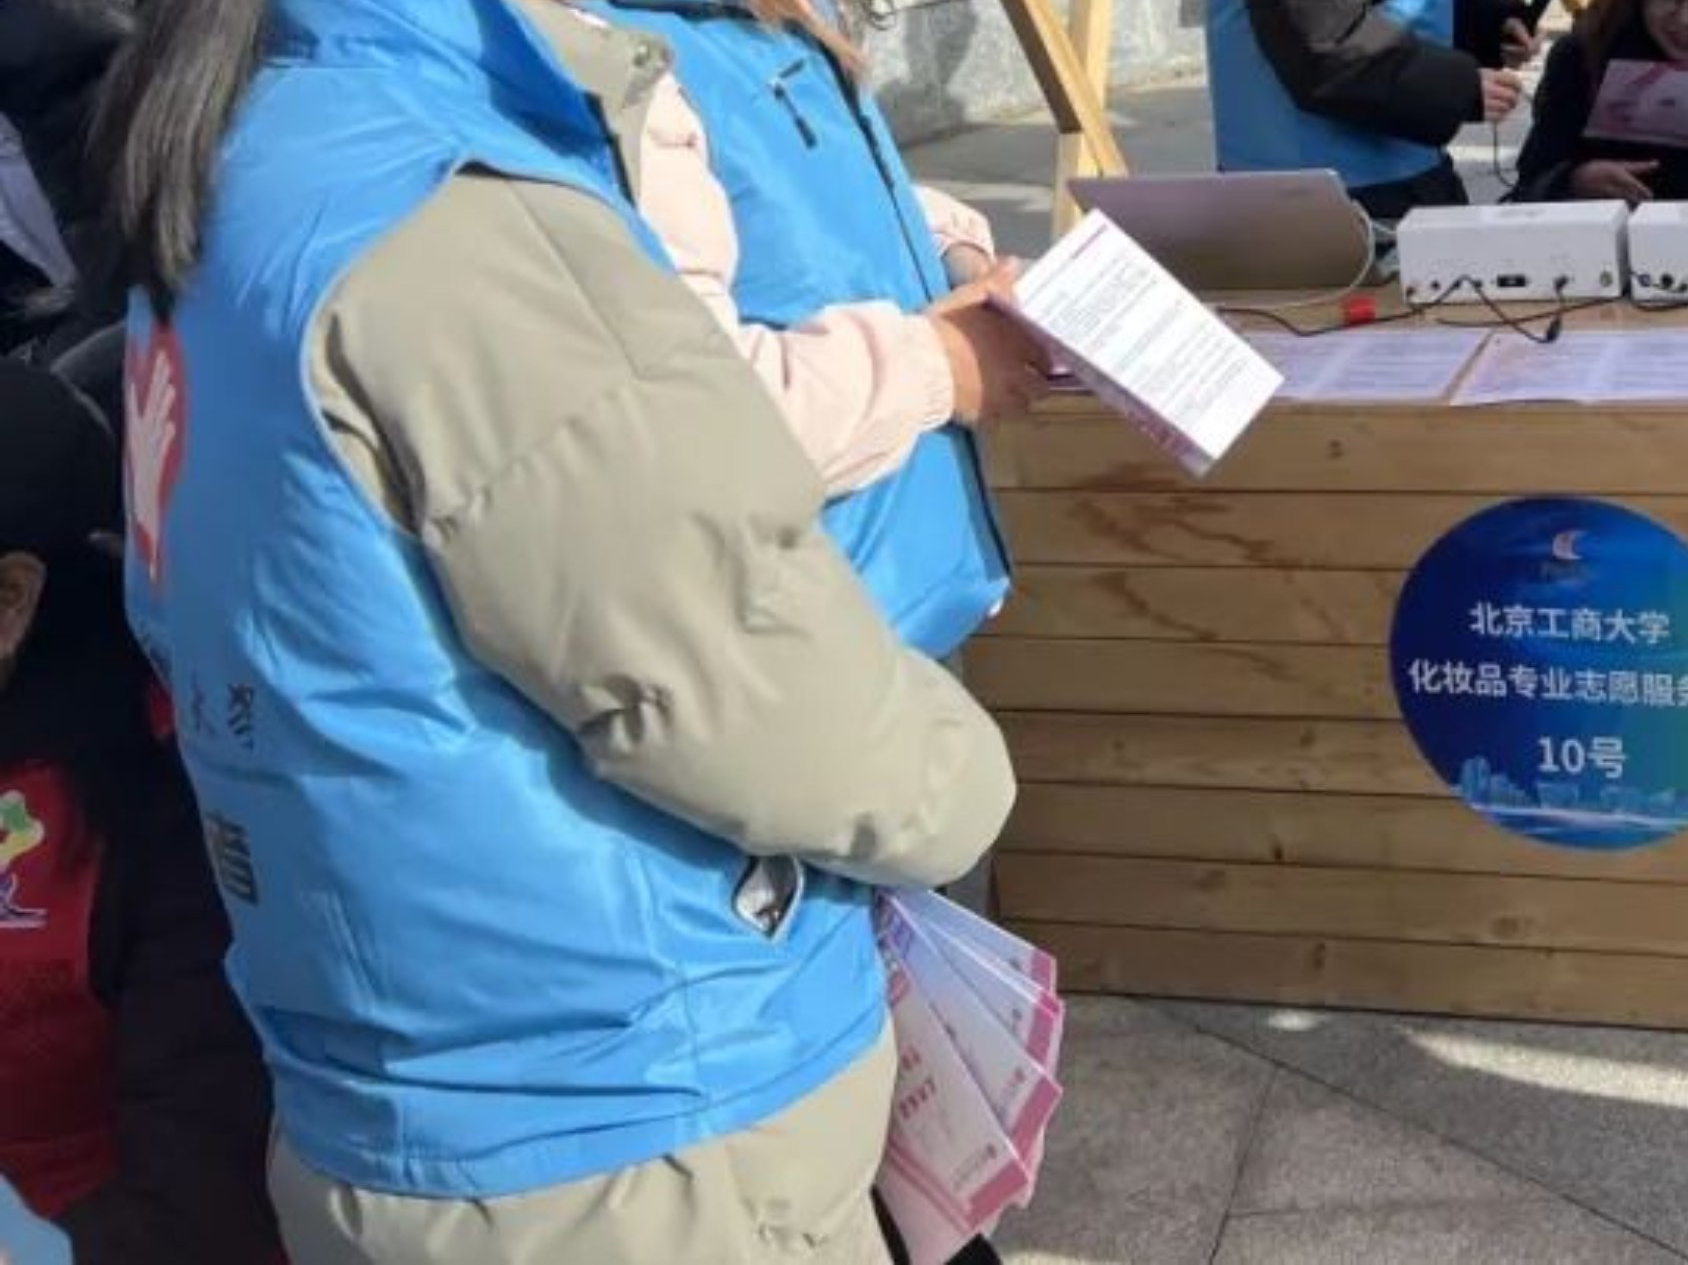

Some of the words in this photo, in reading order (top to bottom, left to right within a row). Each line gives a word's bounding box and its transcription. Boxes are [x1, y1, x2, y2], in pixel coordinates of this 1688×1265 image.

[1468, 601, 1670, 645] 北京工商大学
[1537, 736, 1627, 779] 10号
